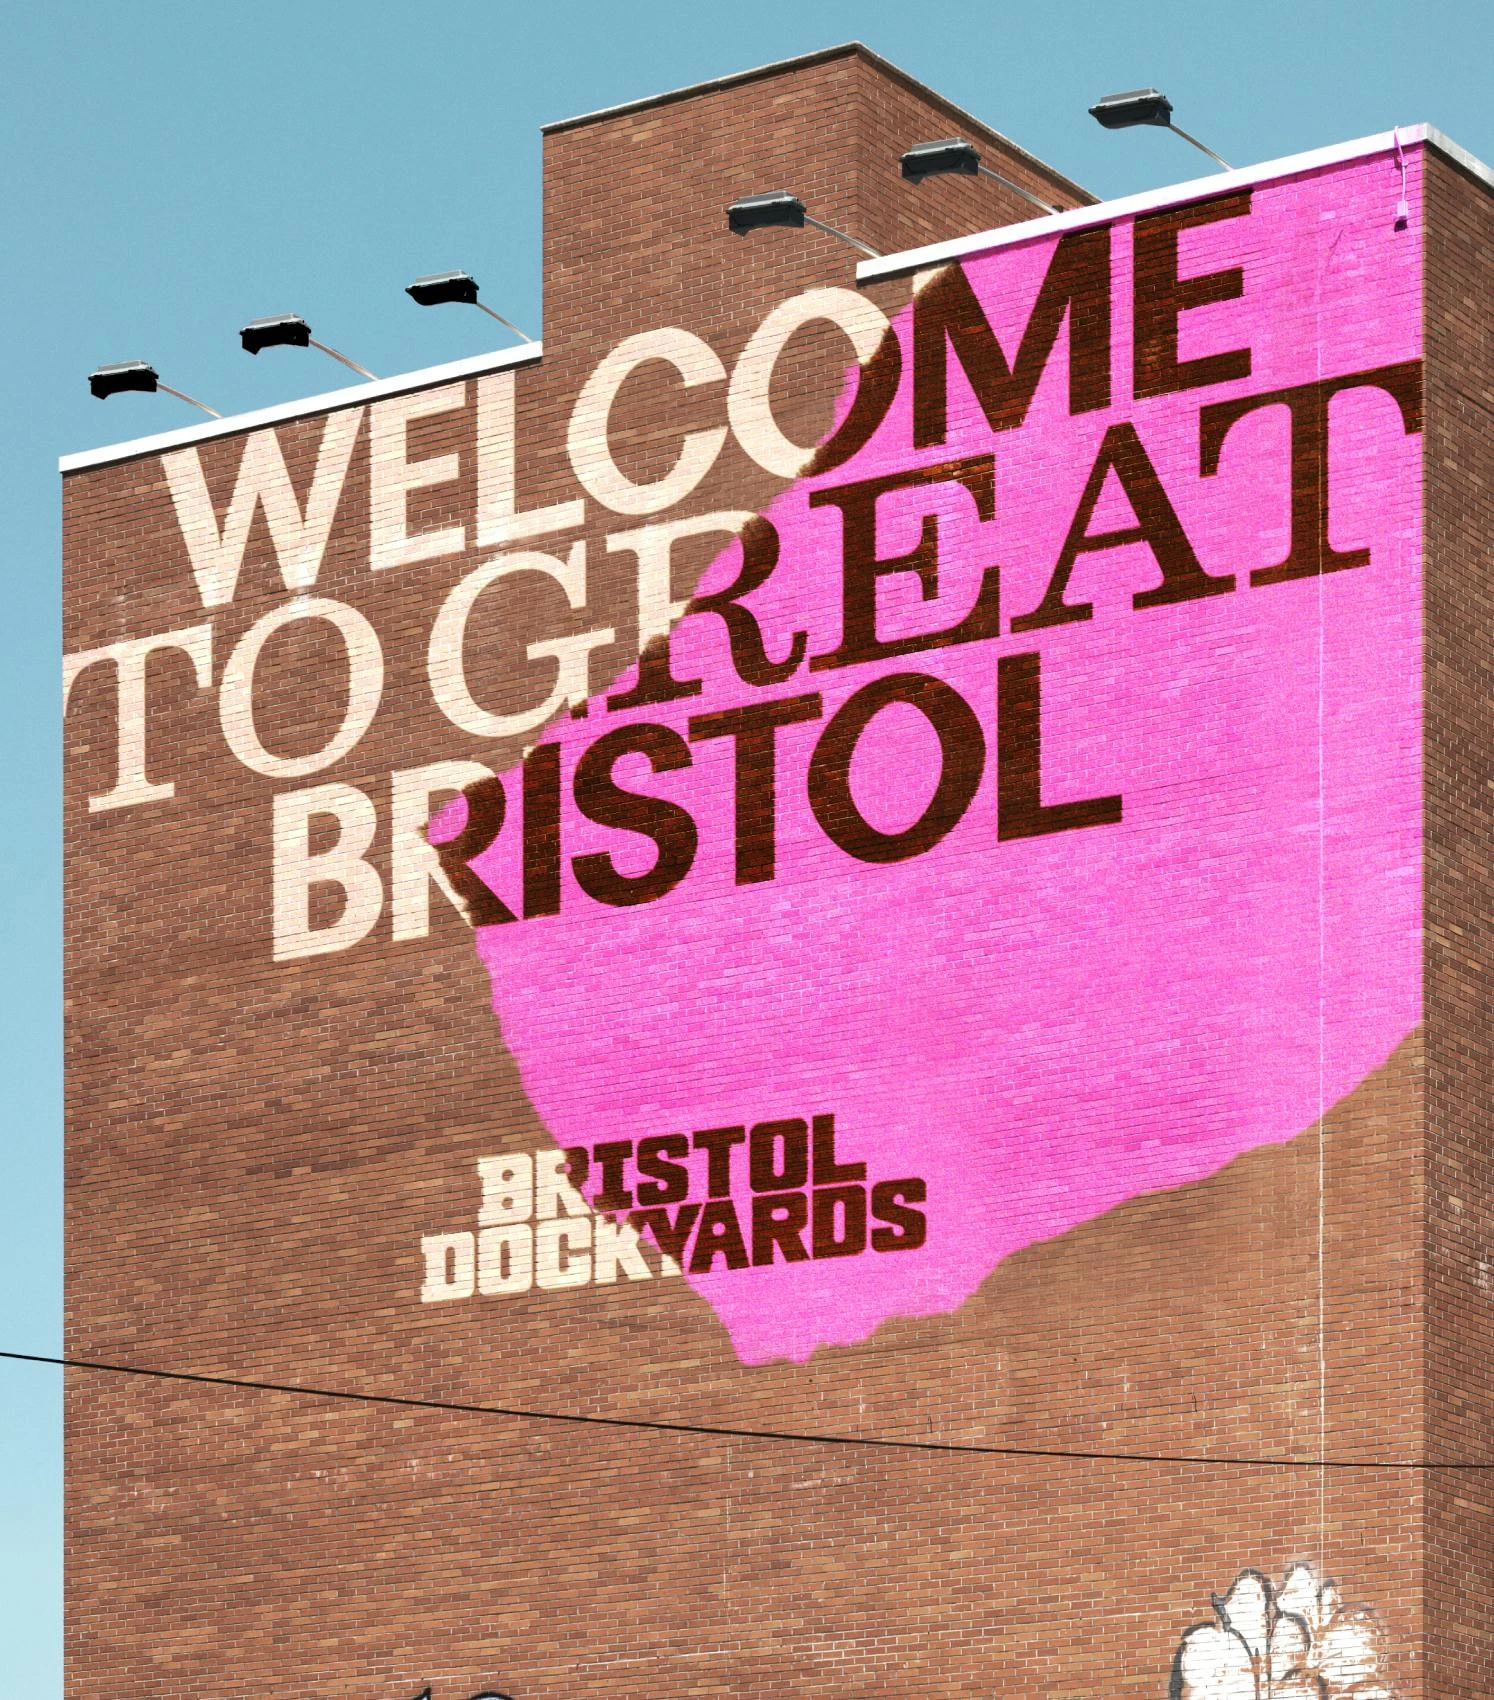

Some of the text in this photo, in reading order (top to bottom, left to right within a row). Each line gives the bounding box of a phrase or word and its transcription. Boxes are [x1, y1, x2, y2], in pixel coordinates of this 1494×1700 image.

[160, 189, 1252, 608] WELCOME
[62, 359, 1423, 813] TO GREAT
[272, 651, 1122, 962] BRISTOL
[420, 1177, 927, 1303] DOCKYARDS
[477, 1114, 867, 1227] BRISTOL
